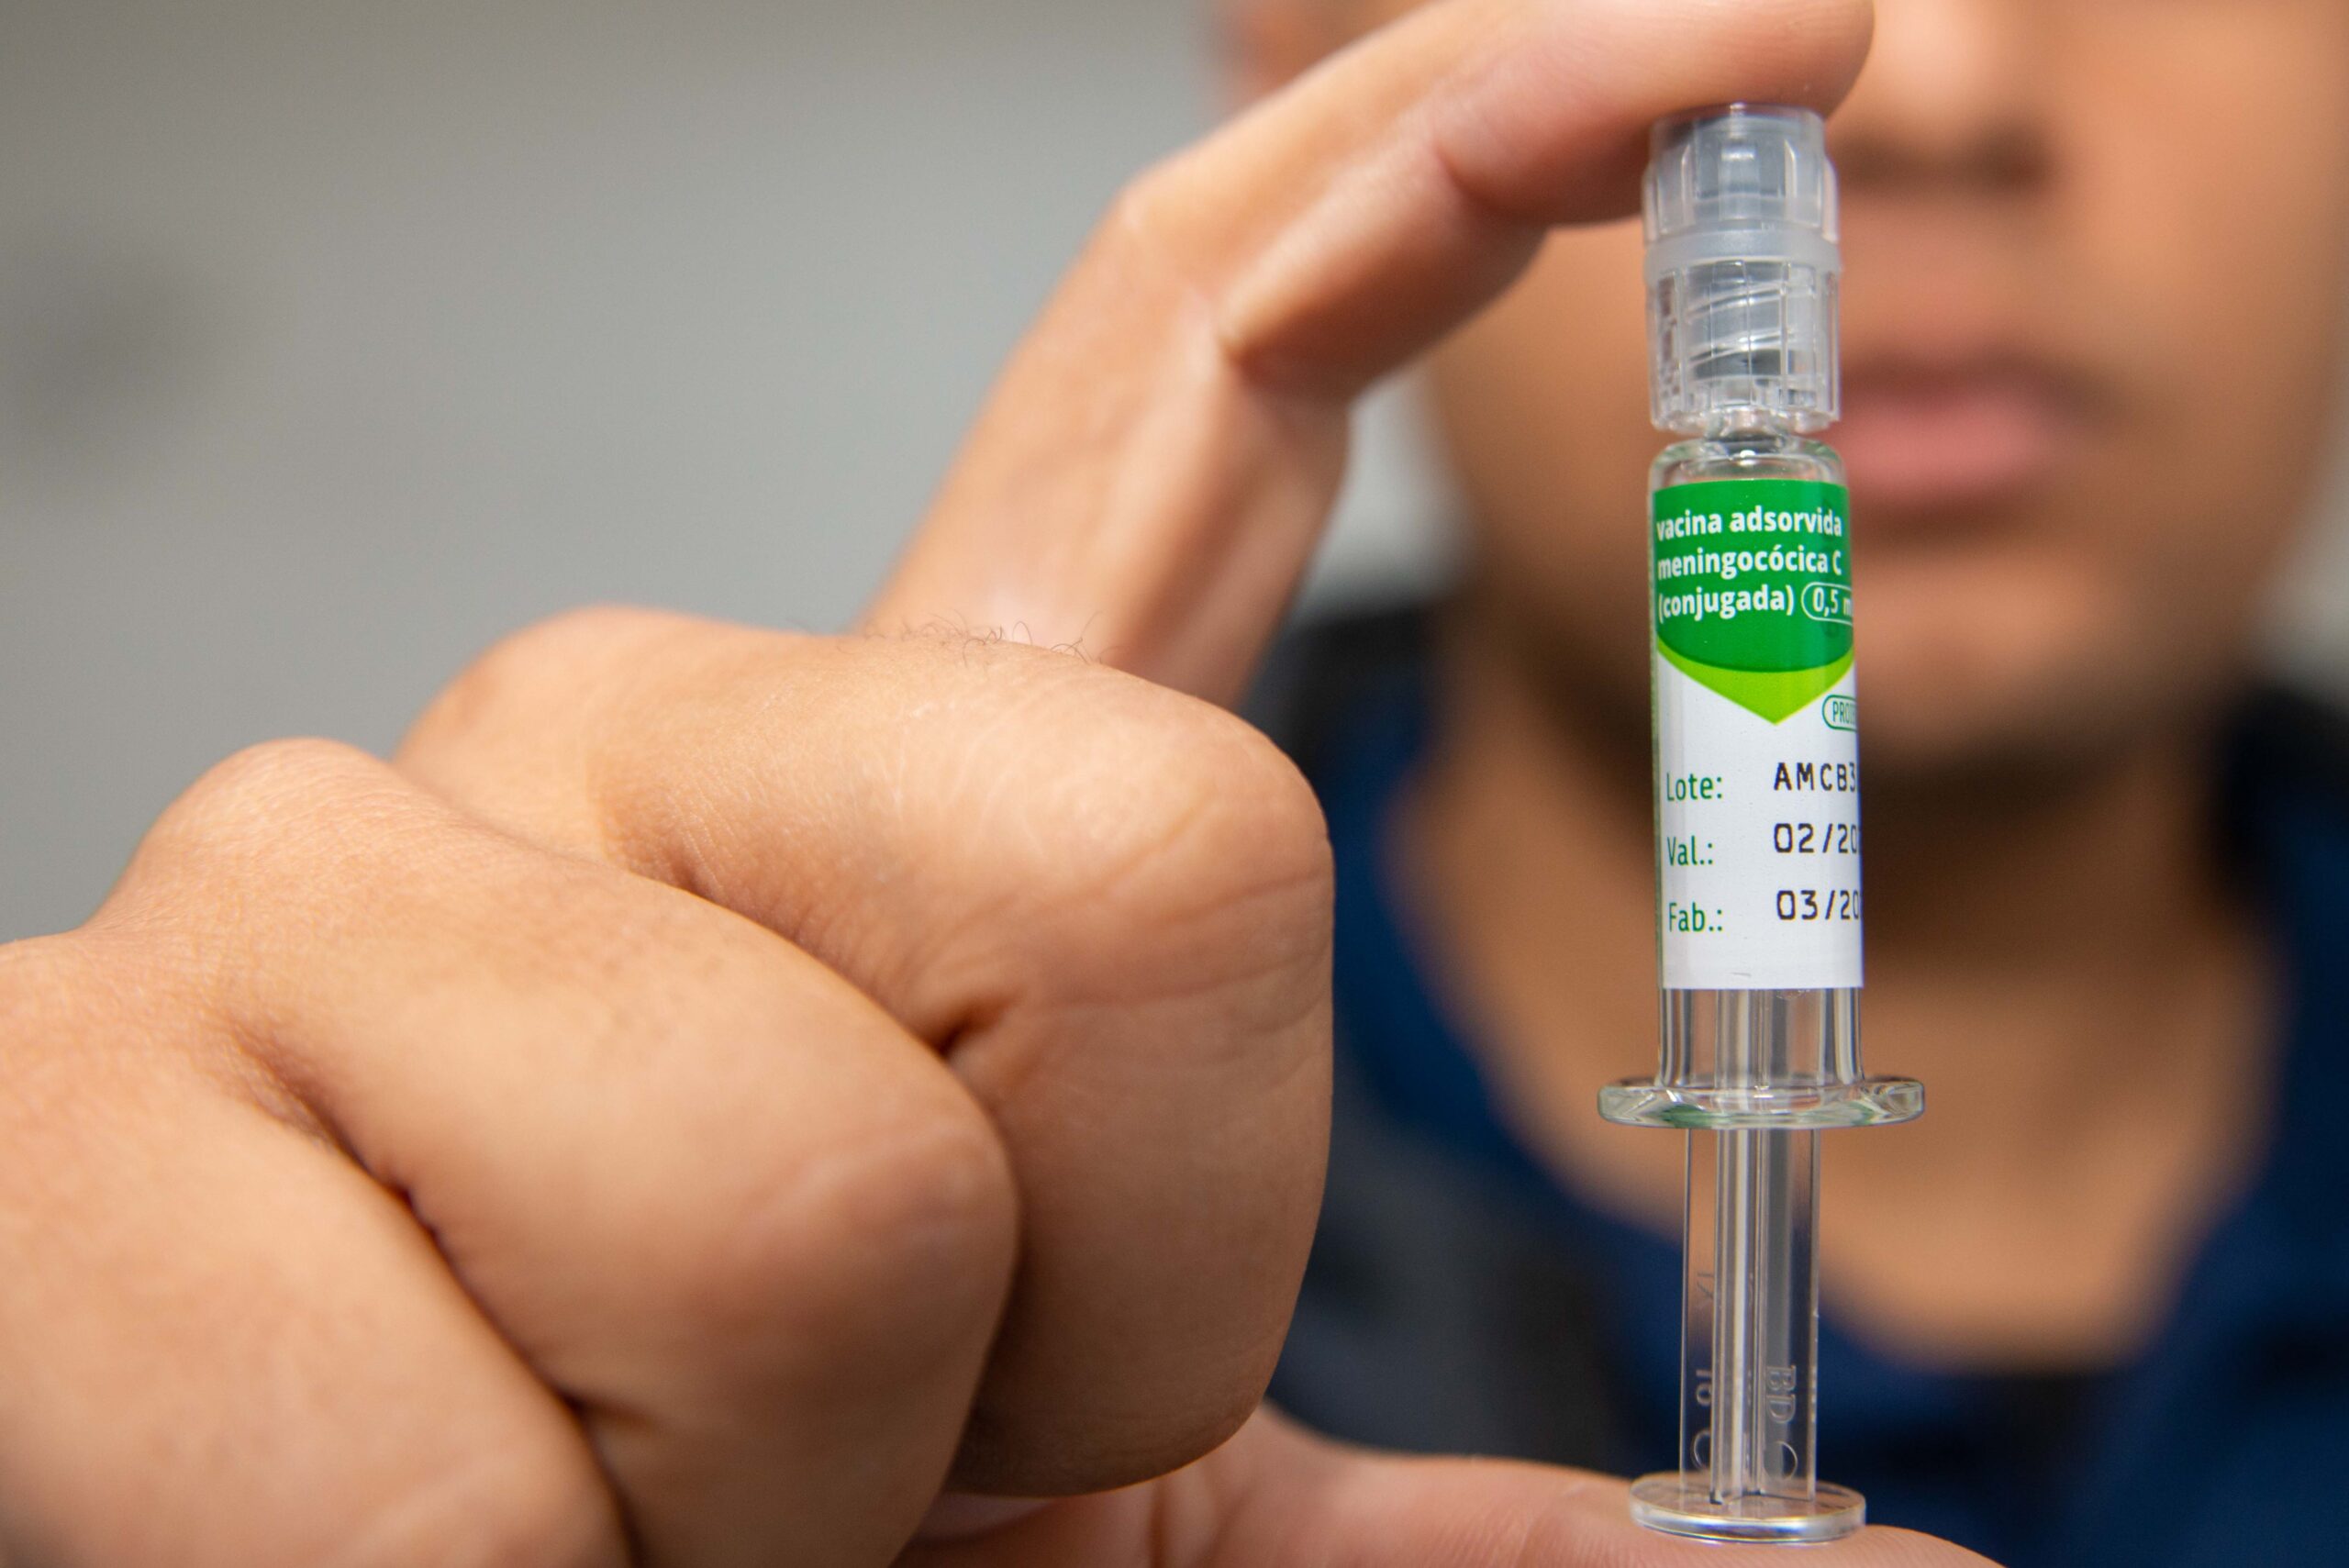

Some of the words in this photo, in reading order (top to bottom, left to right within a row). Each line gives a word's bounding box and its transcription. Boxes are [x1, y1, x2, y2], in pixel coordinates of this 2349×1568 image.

[1656, 509, 1722, 541] vacina
[1730, 506, 1842, 537] adsorvida
[1658, 545, 1829, 580] meningocócica
[1832, 550, 1842, 575] C
[1659, 584, 1795, 624] (conjugada)
[1811, 587, 1839, 617] 0,5
[1665, 773, 1722, 801] Lote:
[1666, 835, 1713, 866] Val.:
[1668, 902, 1722, 932] Fab.:
